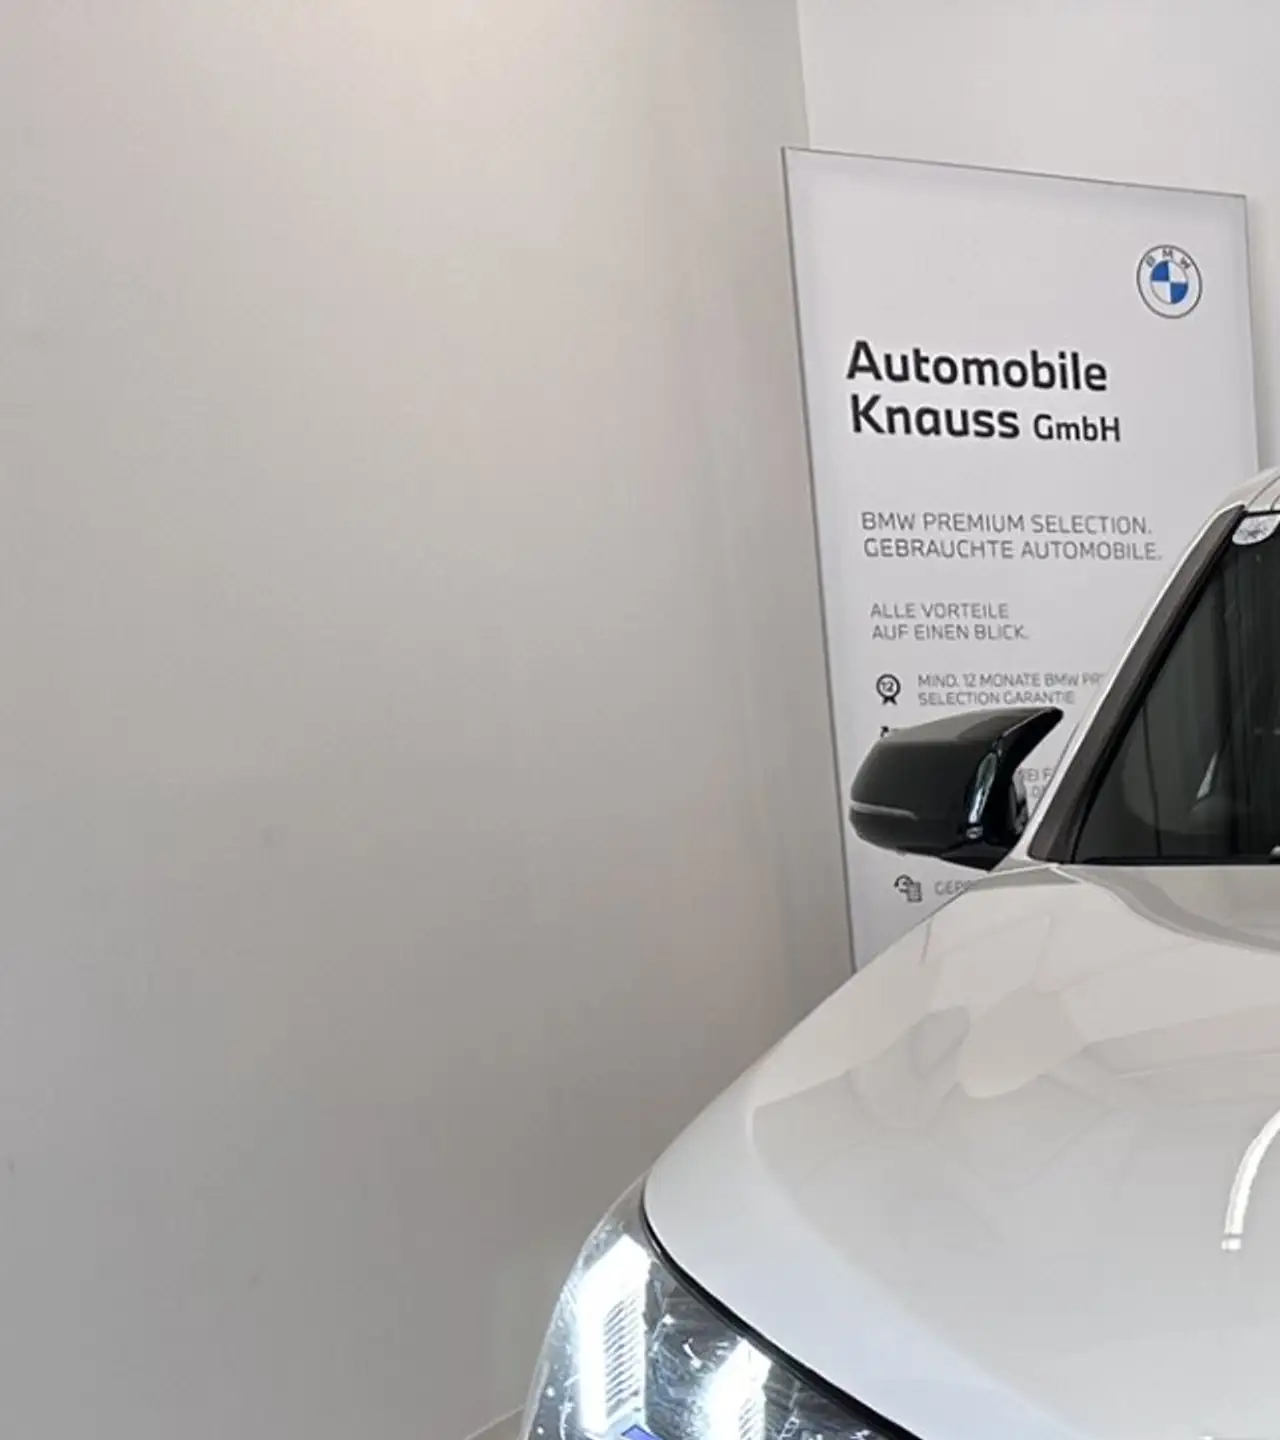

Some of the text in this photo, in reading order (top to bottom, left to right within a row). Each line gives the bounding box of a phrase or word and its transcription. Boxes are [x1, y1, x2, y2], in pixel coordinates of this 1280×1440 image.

[847, 340, 1107, 391] Automobile
[851, 394, 1121, 443] Knauss GmbH
[861, 511, 1153, 536] BMW PREMIUM SELECTION.
[864, 537, 1163, 561] GEBRAUCHTE AUTOMOBILE.
[870, 602, 1009, 620] ALLE VORTEILE
[872, 623, 1030, 641] AUF EINEN BLICK.
[962, 673, 977, 689] 12
[979, 673, 1041, 688] MONATE
[1044, 673, 1079, 688] BMW
[917, 691, 1001, 707] SELECTION
